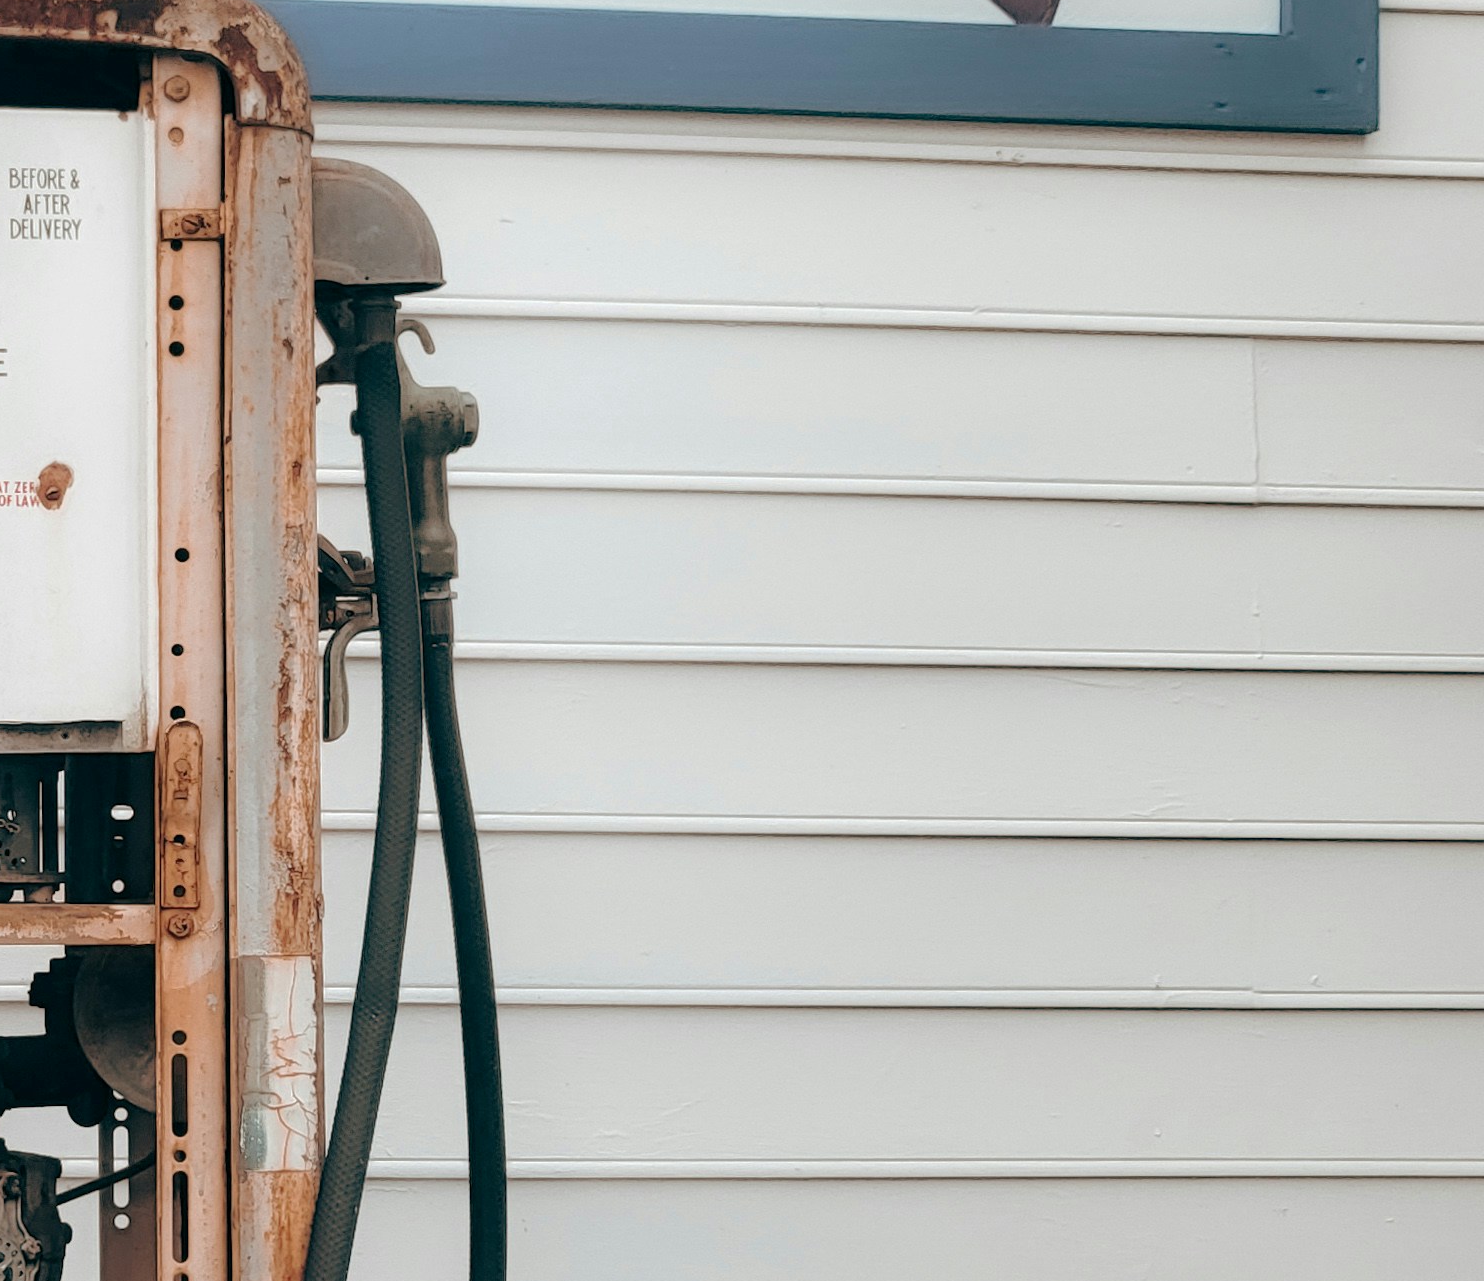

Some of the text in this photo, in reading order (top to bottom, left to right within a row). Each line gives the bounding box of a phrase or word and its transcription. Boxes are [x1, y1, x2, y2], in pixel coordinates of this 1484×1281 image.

[9, 168, 80, 190] BEFORE &
[23, 194, 70, 215] AFTER
[10, 218, 82, 240] DELIVERY
[15, 481, 38, 494] ZER
